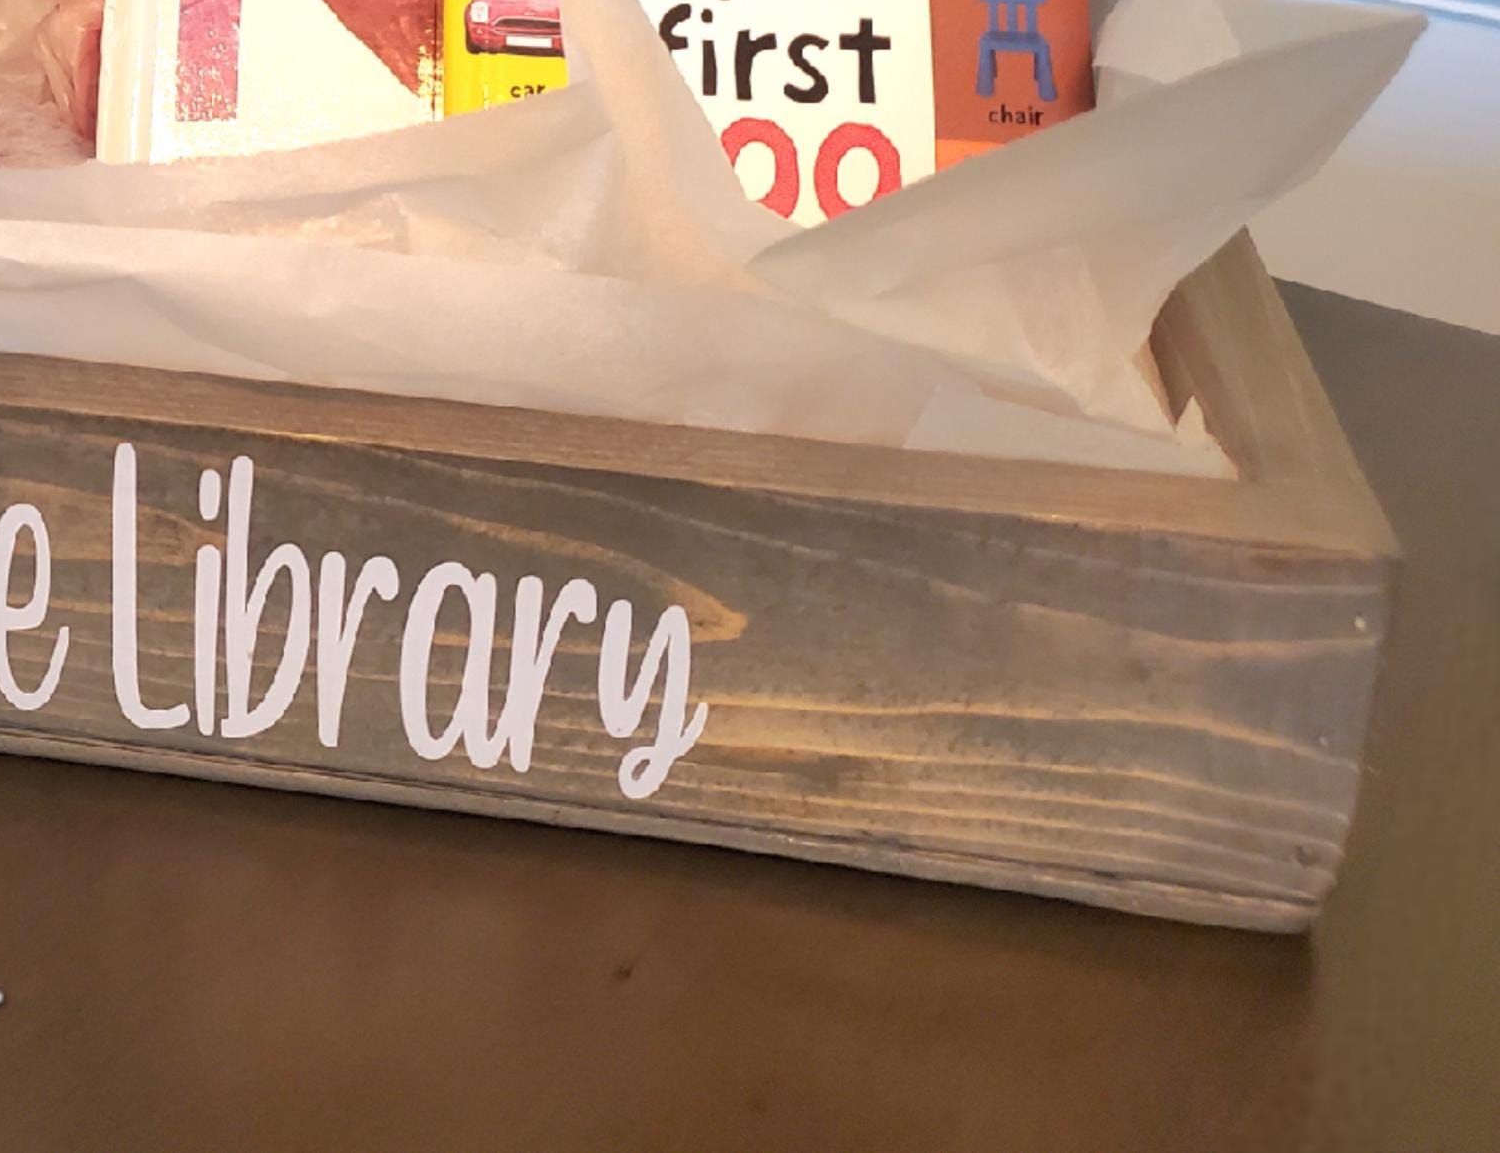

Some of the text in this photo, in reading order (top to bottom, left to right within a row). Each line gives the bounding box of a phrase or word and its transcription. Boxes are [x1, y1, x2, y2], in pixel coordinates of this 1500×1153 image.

[659, 3, 891, 104] first
[988, 105, 1044, 127] chair
[721, 117, 901, 220] 00
[112, 443, 708, 799] Library
